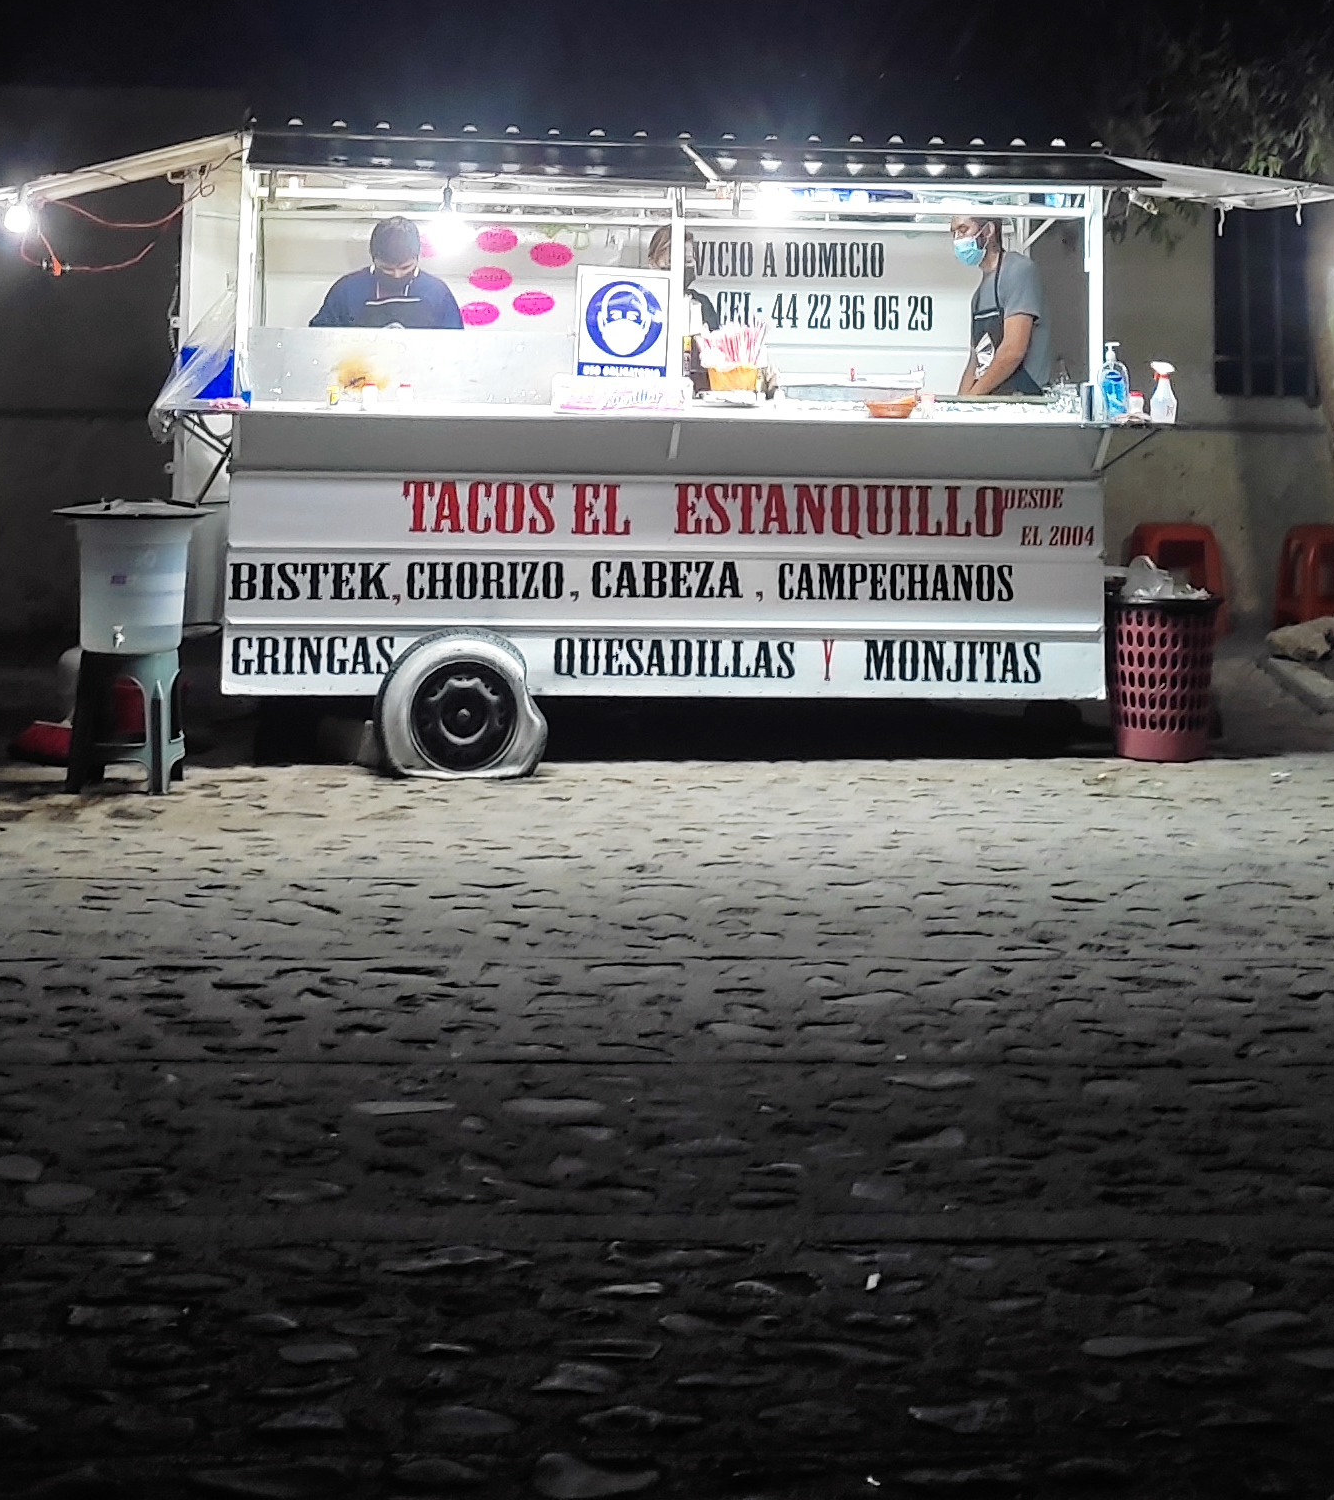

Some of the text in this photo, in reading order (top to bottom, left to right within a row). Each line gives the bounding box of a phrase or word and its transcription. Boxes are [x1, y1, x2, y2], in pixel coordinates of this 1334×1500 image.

[694, 241, 885, 278] VICIO A DOMICIO
[771, 293, 799, 328] 44
[807, 294, 831, 329] 22
[839, 295, 865, 330] 36
[874, 296, 899, 331] 05
[907, 296, 933, 331] 29
[402, 480, 1006, 539] TACOS EL ESTANQUILLO
[1003, 487, 1064, 510] DESDE
[1020, 525, 1095, 547] EL 2004
[778, 562, 1014, 602] CAMPECHANOS
[231, 636, 1041, 684] GRINGAS QUESADILLAS Y MONJITAS
